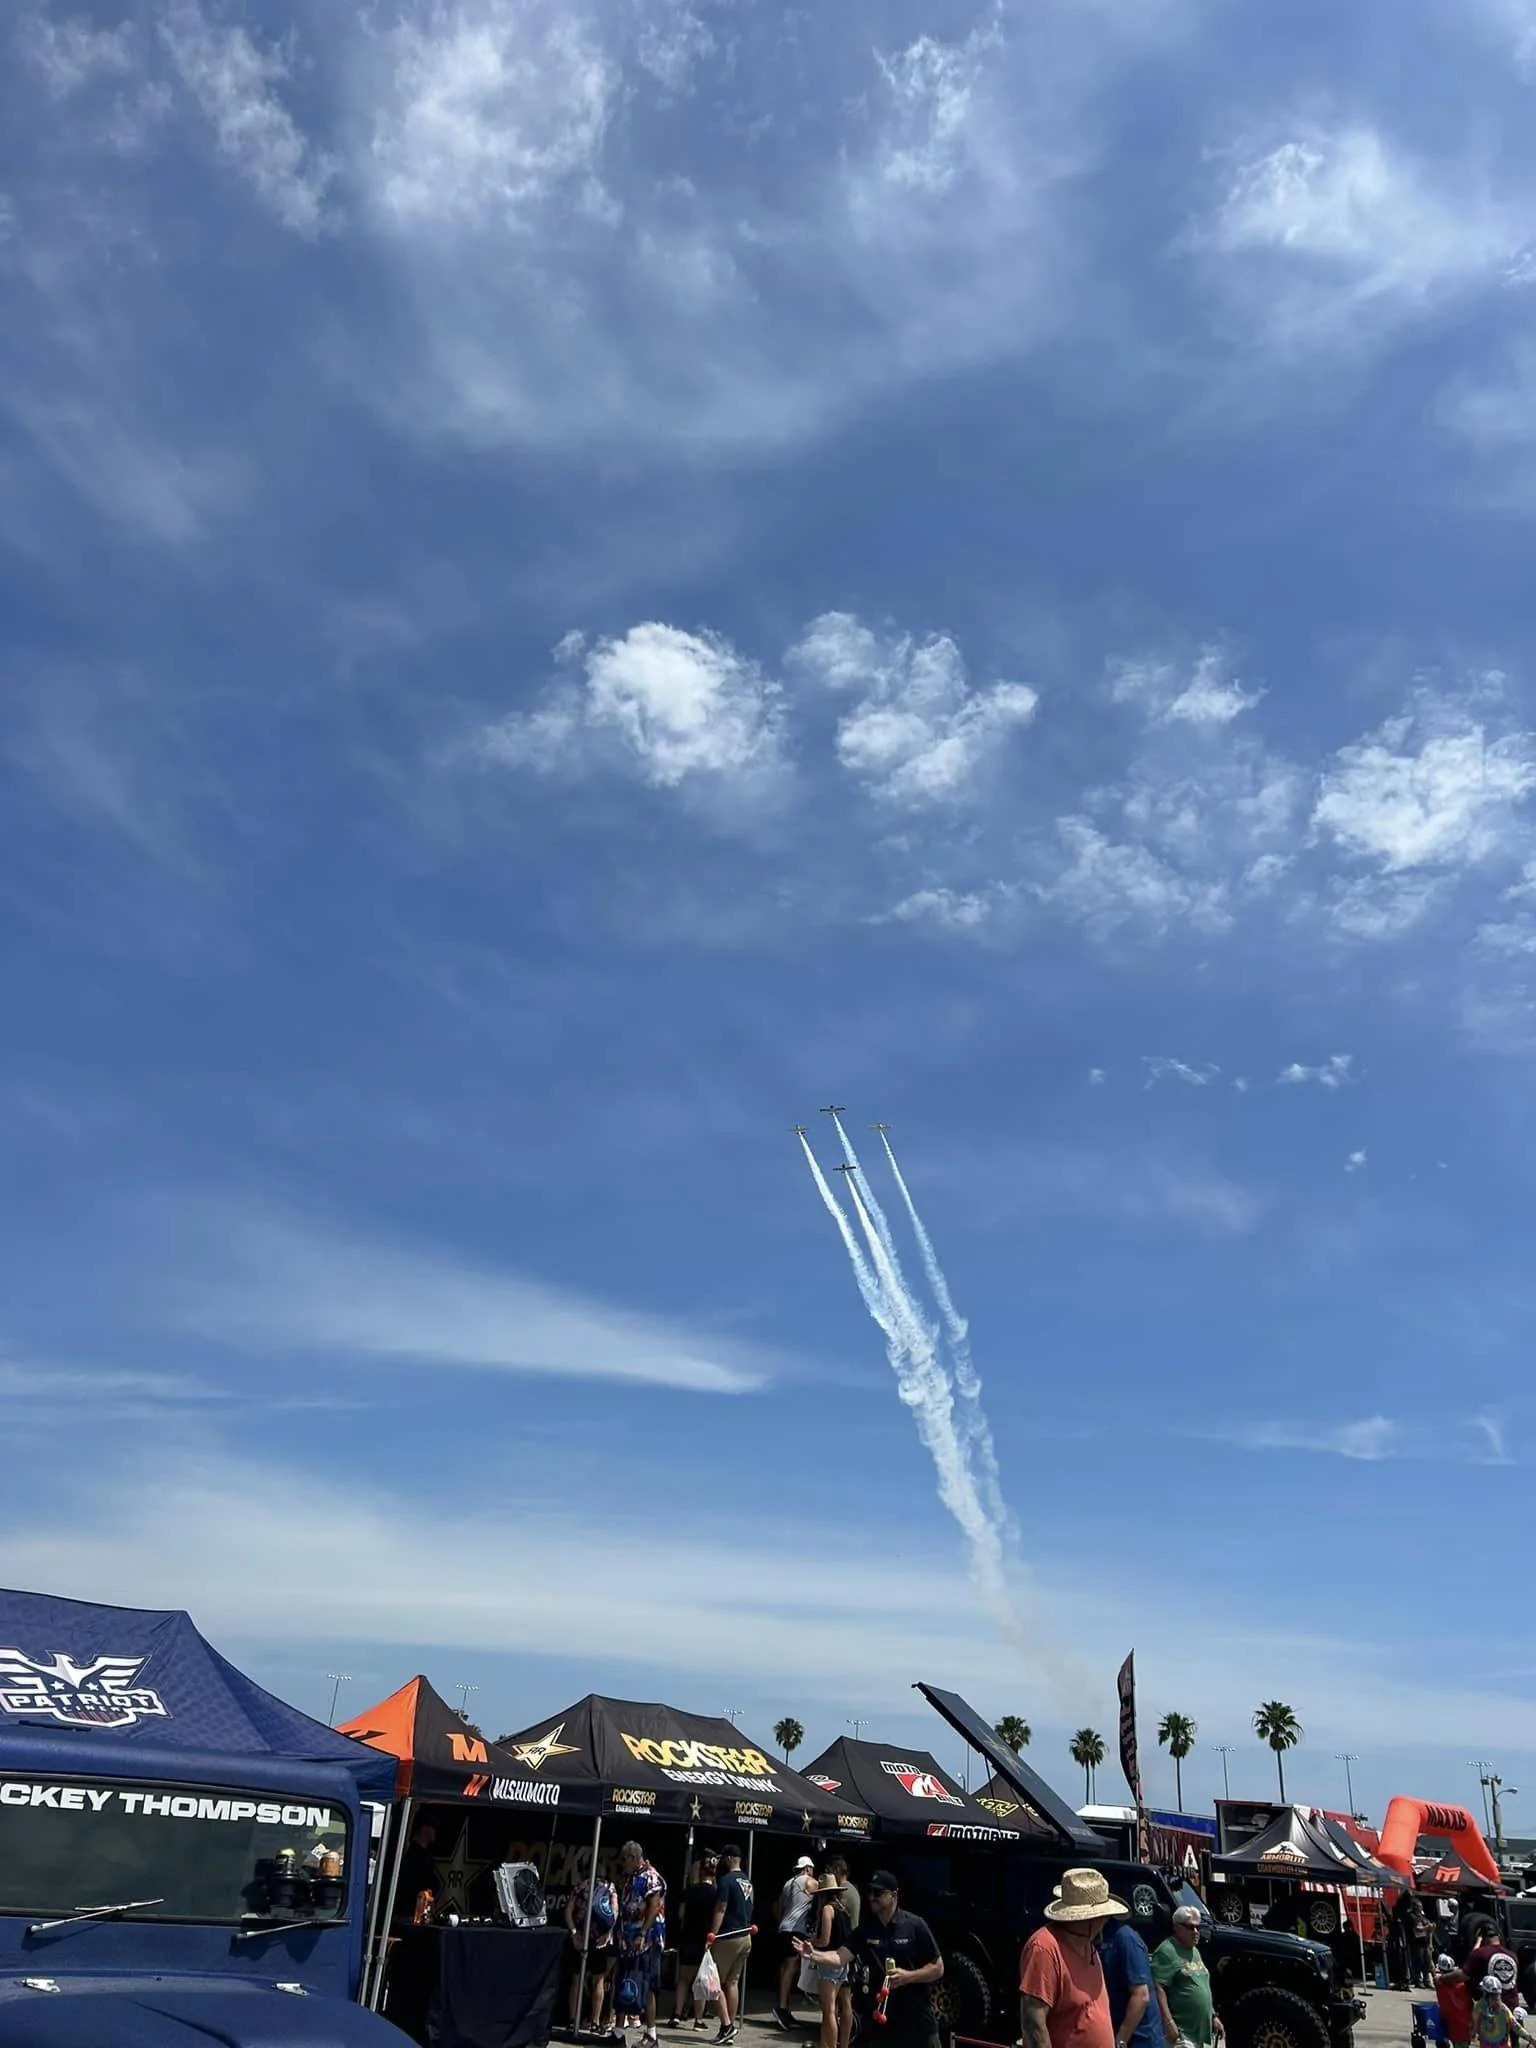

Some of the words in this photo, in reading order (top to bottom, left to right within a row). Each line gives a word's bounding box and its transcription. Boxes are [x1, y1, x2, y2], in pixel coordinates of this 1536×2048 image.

[7, 1693, 151, 1708] PATRIOT
[620, 1732, 778, 1775] ROCKSTAR
[882, 1763, 920, 1774] MOTO
[492, 1777, 561, 1806] MISHIMOTO
[660, 1768, 734, 1786] ENERGY
[729, 1774, 783, 1794] DRINK
[0, 1782, 113, 1812] CKEY
[118, 1791, 331, 1828] THOMPSON
[612, 1788, 657, 1806] ROCKSTAR
[734, 1801, 773, 1817] ROCKSTAR
[1425, 1804, 1467, 1832] MAXXIS
[837, 1814, 869, 1829] ROCKSTAR
